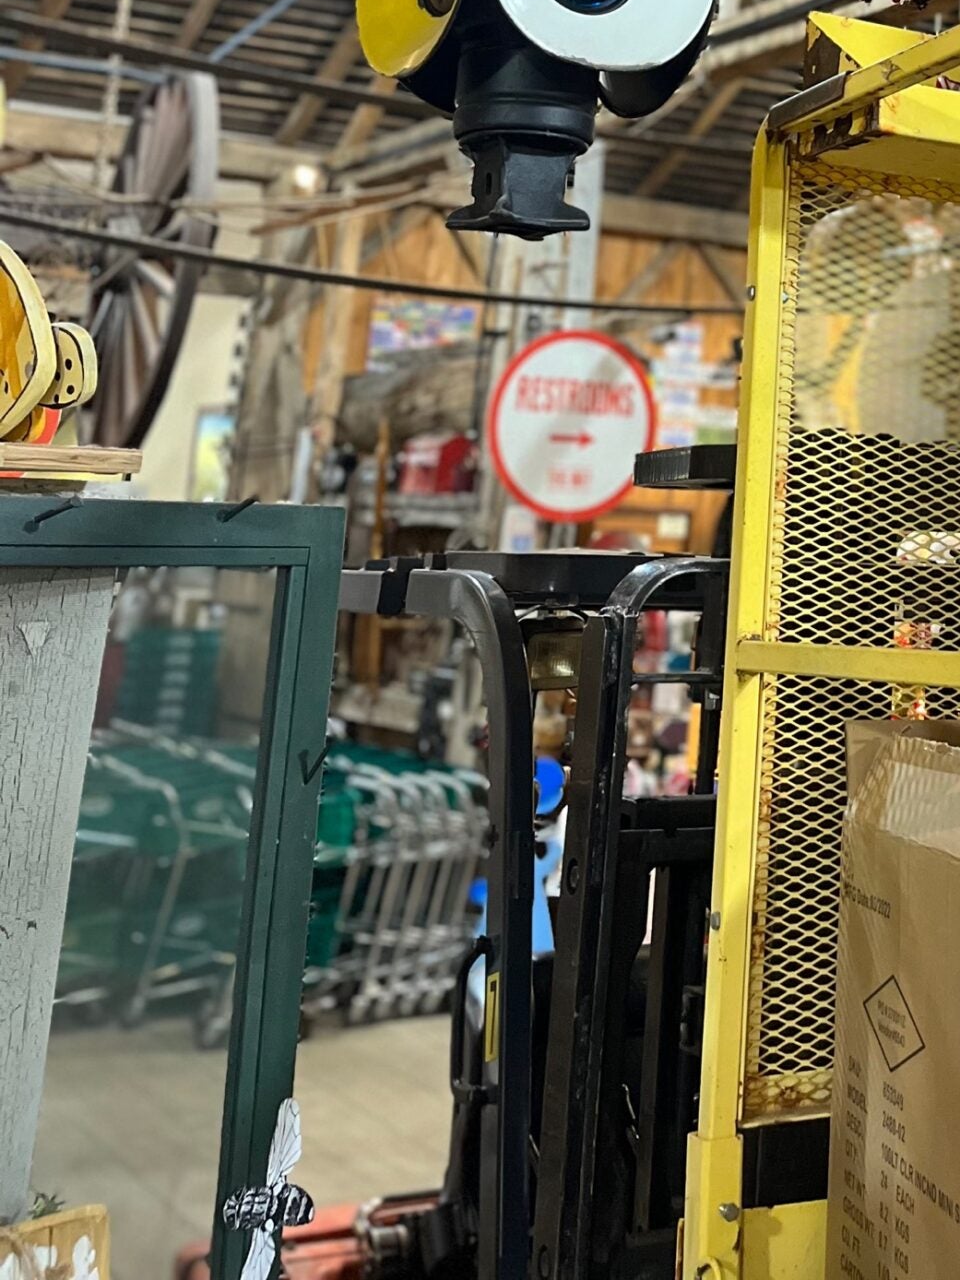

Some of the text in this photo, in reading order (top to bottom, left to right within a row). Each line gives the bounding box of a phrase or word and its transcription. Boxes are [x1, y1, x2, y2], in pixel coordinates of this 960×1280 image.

[515, 374, 635, 418] RESTROOMS
[900, 1157, 914, 1184] CLR
[896, 1184, 915, 1215] EACH
[894, 1215, 909, 1244] KGS
[894, 1246, 909, 1274] KGS
